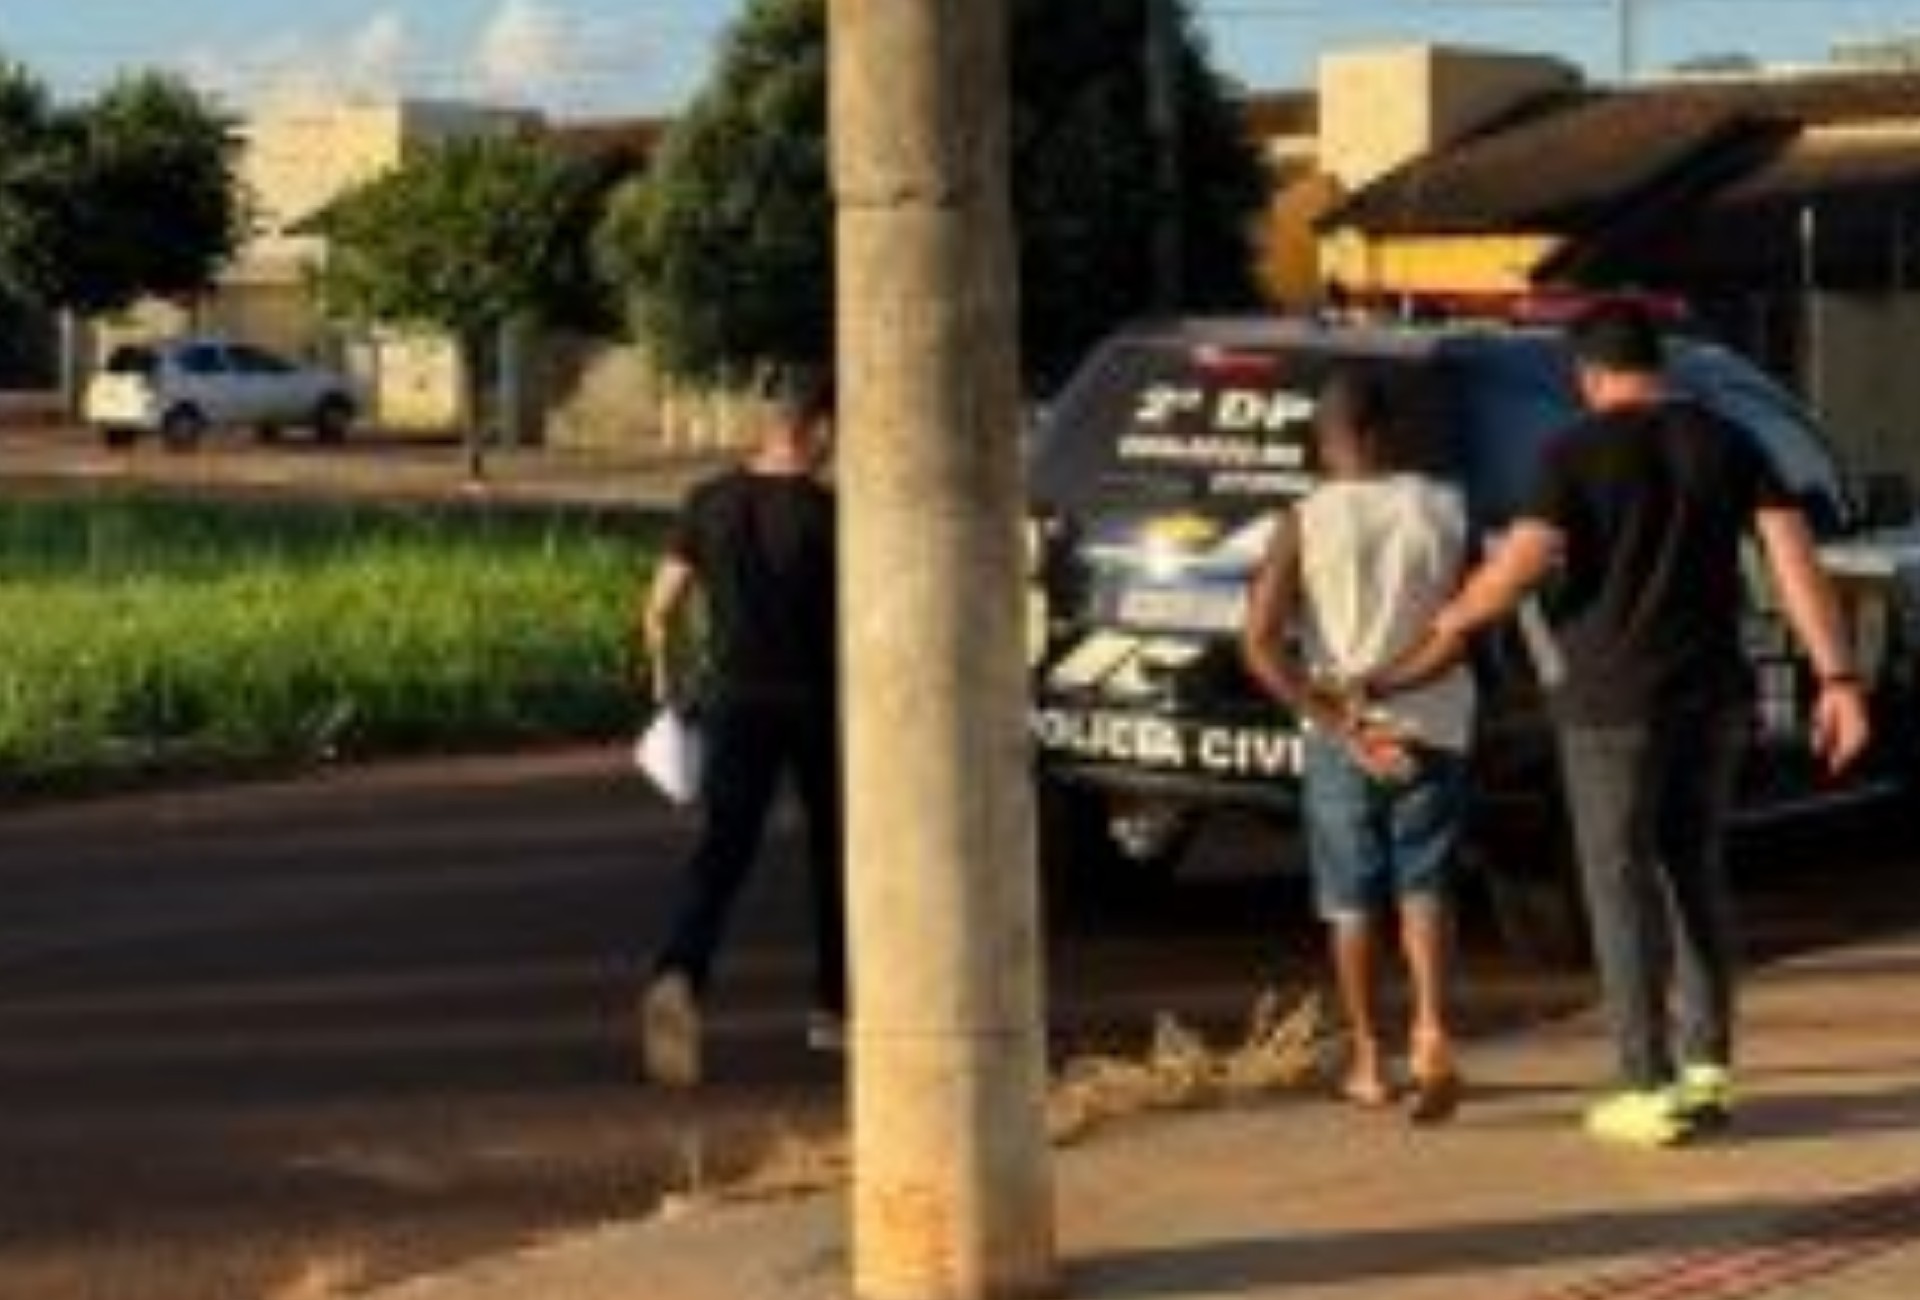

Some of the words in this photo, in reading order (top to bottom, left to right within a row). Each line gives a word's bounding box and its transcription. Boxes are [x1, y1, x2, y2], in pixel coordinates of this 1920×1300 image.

[1214, 388, 1315, 430] DP
[1033, 708, 1184, 767] OLICIA
[1200, 725, 1306, 777] CIVI
